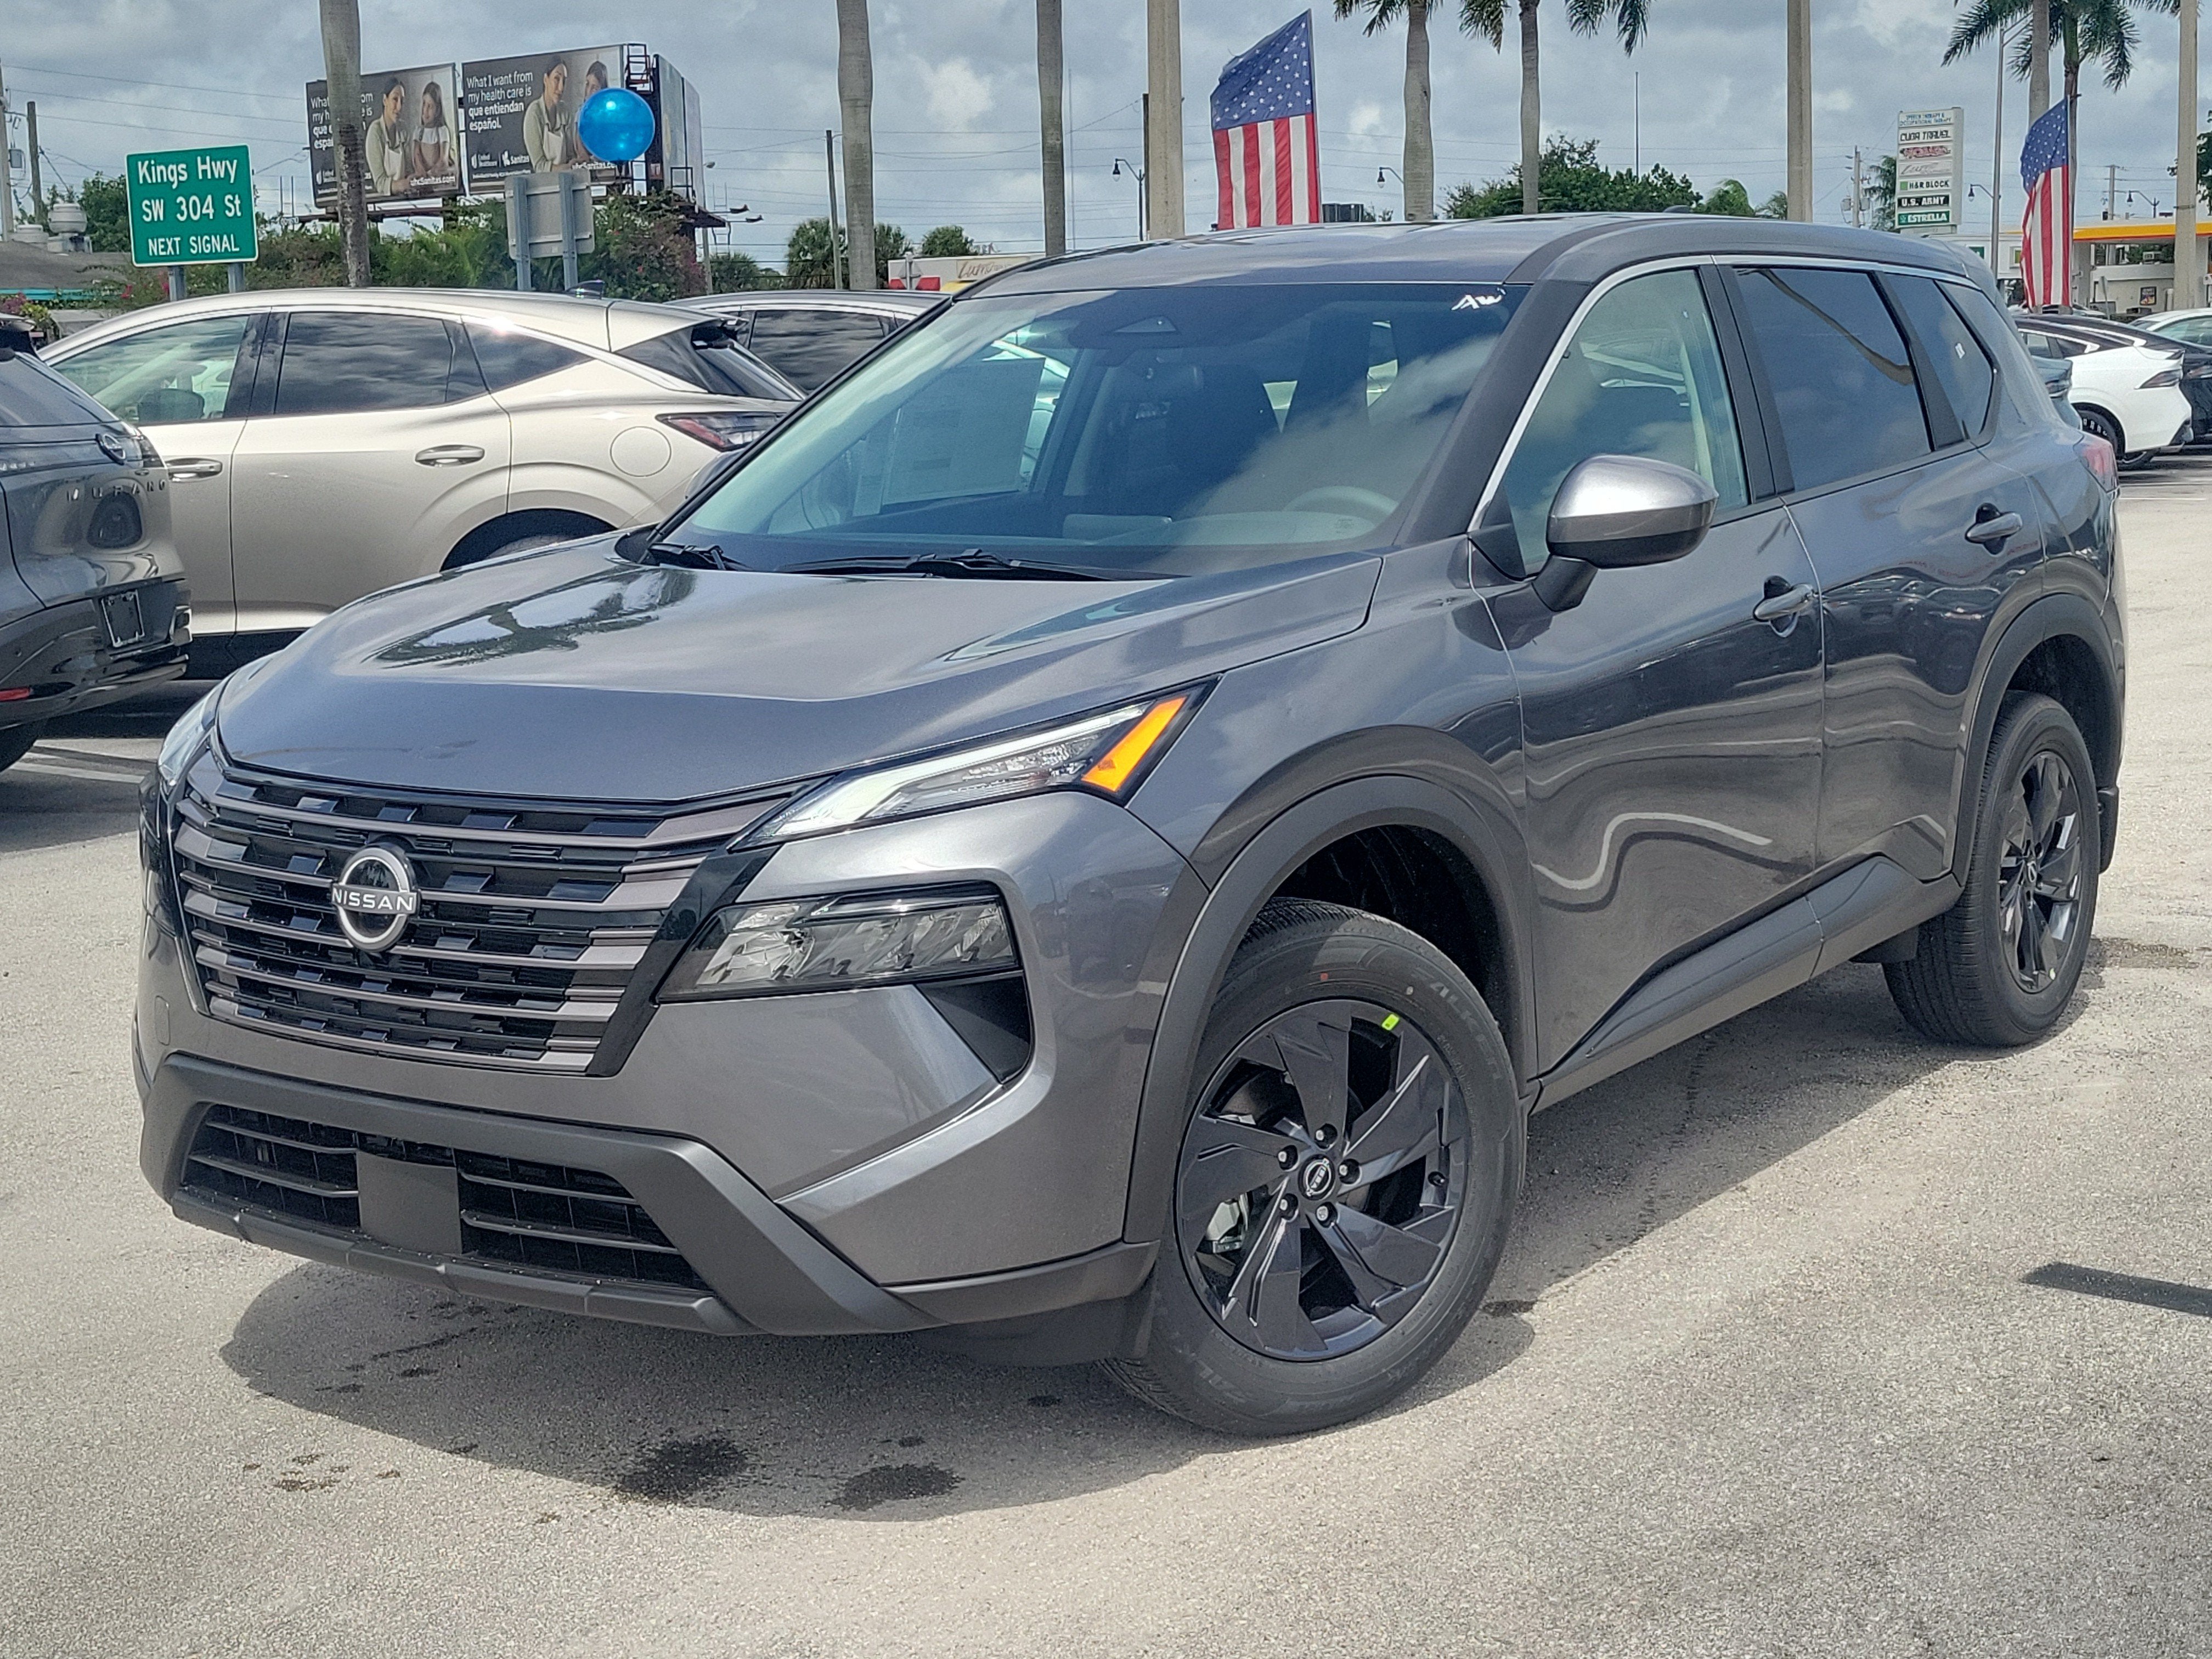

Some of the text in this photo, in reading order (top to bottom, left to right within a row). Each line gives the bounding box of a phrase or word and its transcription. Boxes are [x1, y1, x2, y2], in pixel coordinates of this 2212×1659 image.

[466, 71, 533, 88] What I want from
[468, 84, 532, 105] my health care is
[312, 112, 324, 125] my
[469, 100, 524, 120] que entiendan
[313, 126, 328, 138] que
[469, 116, 502, 134] español.
[138, 155, 238, 190] Kings Hwy
[1926, 179, 1949, 189] BLOCK
[142, 194, 241, 222] SW 304 St
[1901, 196, 1945, 207] U.S. ARMY
[1908, 212, 1948, 223] ESTRELLA
[148, 234, 240, 256] NEXT SIGNAL
[67, 478, 166, 501] MURANO
[331, 887, 414, 911] NISSAN
